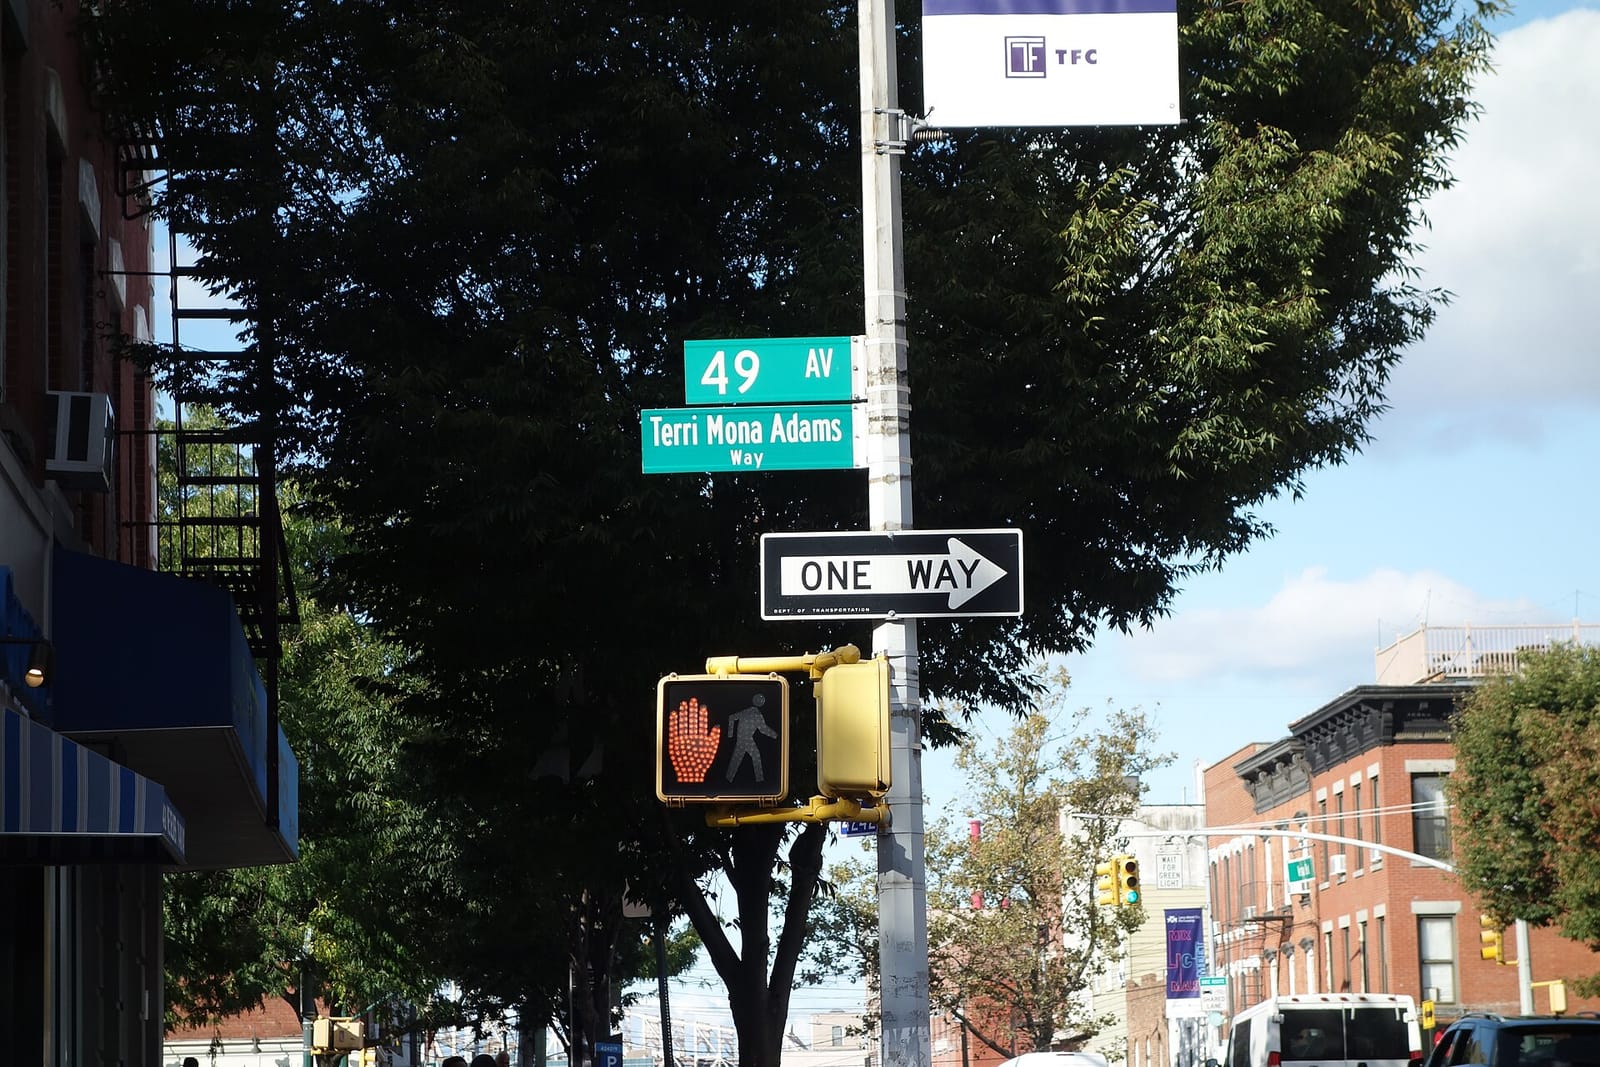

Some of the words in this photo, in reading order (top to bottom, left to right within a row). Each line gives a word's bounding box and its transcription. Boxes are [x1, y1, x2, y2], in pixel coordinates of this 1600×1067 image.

[1055, 48, 1098, 65] TFC
[701, 349, 760, 395] 49
[805, 348, 834, 379] AV
[650, 415, 699, 447] Terri
[707, 414, 762, 445] Mona
[770, 412, 842, 443] Adams
[730, 450, 764, 469] Way
[801, 560, 872, 591] ONE
[908, 559, 981, 590] WAY
[1159, 872, 1180, 880] GREEN
[1169, 930, 1191, 941] MIX
